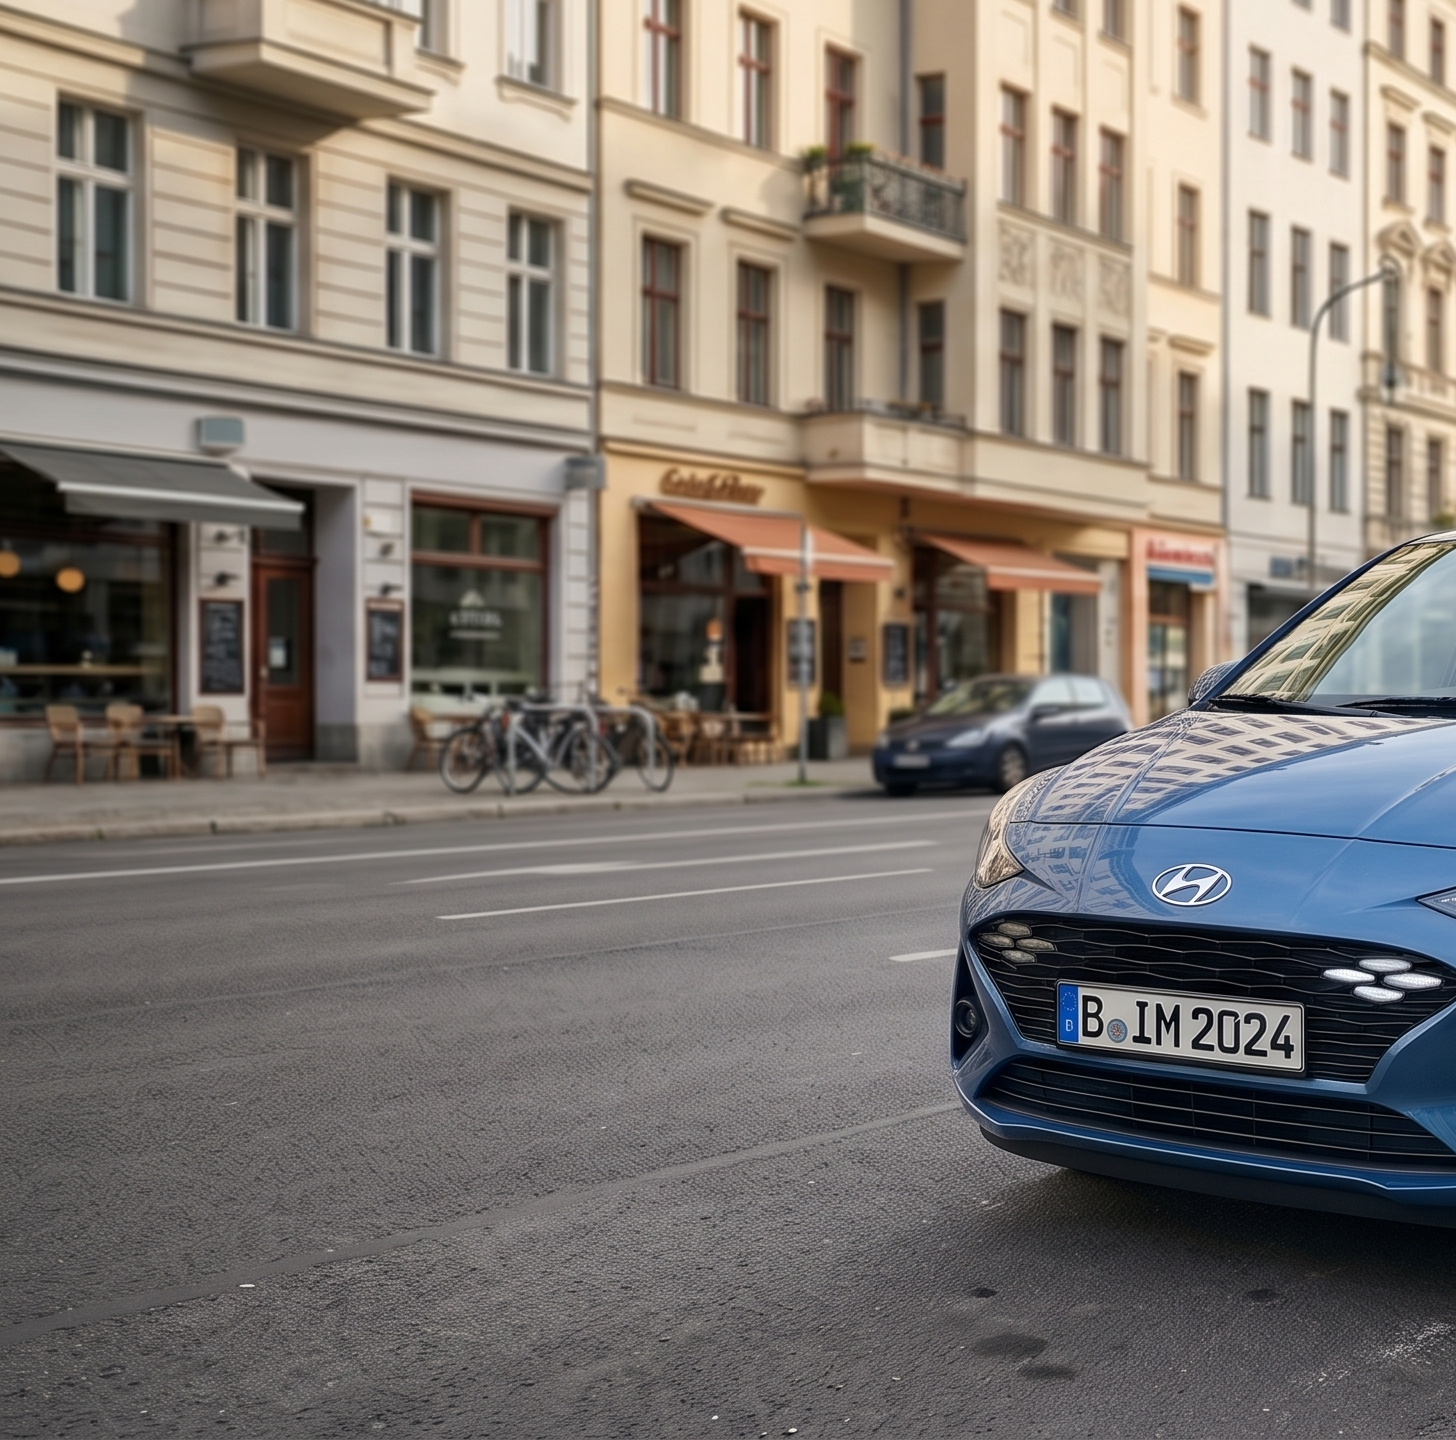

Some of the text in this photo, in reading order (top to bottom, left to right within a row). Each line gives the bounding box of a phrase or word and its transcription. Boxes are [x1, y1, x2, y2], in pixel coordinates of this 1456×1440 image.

[1081, 994, 1295, 1059] B IM 2024
